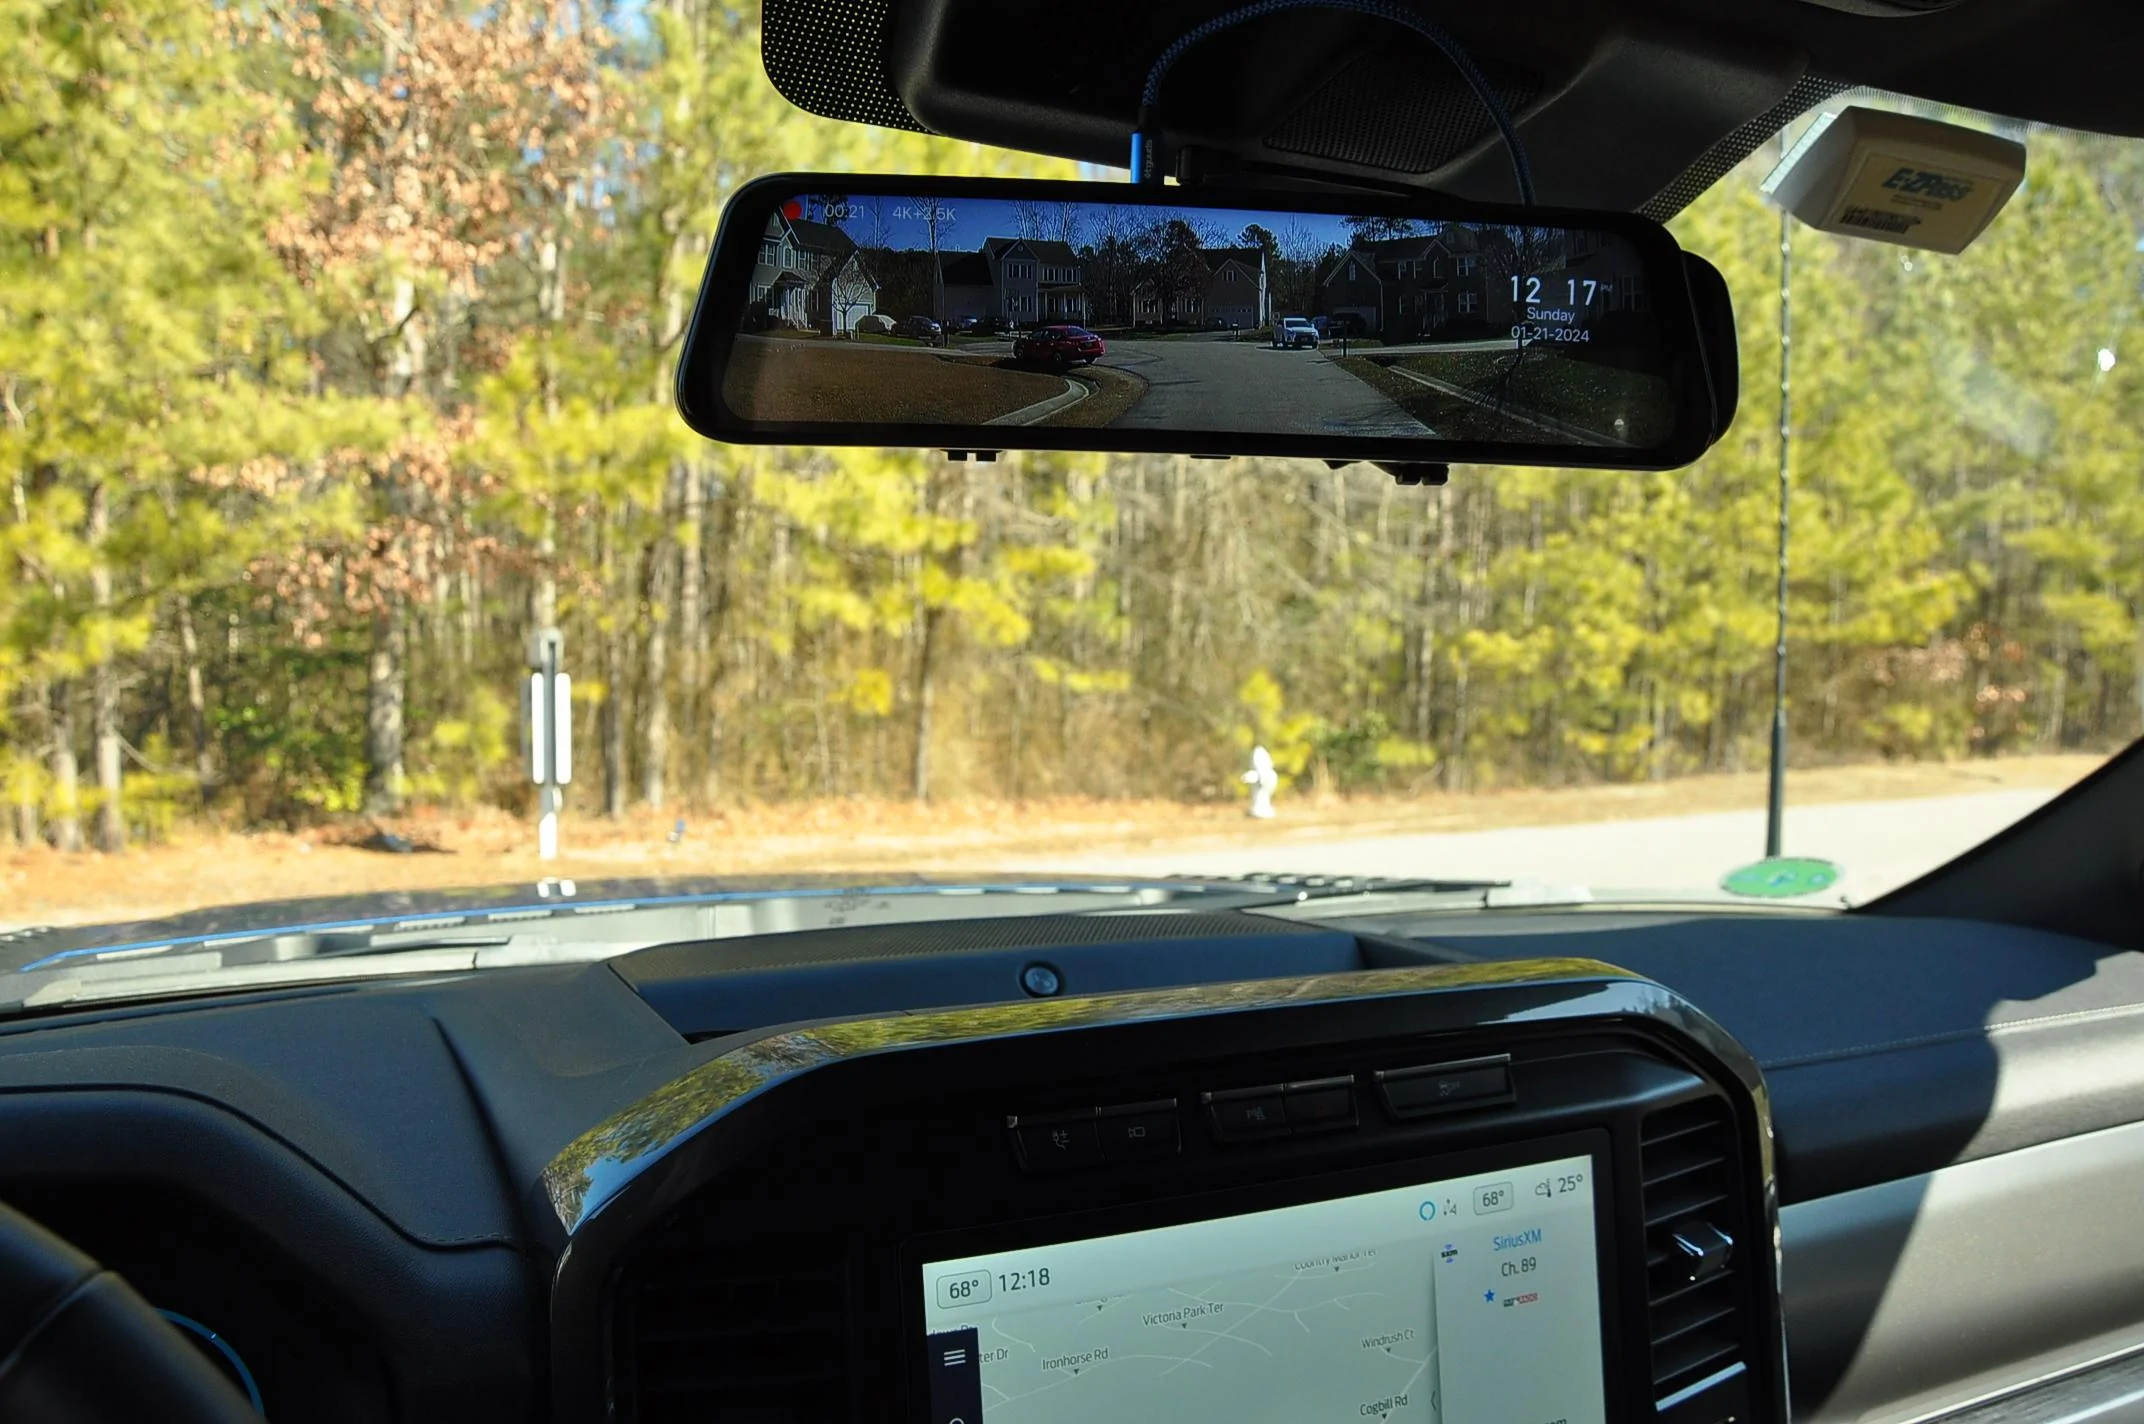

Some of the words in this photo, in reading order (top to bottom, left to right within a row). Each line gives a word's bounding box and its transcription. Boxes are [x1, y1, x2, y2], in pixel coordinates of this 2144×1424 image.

[825, 203, 865, 219] 00:21
[1526, 306, 1576, 325] Sunday
[1511, 325, 1590, 343] 01-21-2024
[1558, 1174, 1584, 1194] 25°
[1492, 1228, 1543, 1252] SiriusXM
[1521, 1256, 1537, 1273] 89
[949, 1279, 980, 1300] 68°
[998, 1267, 1051, 1293] 12:18
[1142, 1308, 1182, 1327] Victoria
[1183, 1304, 1206, 1319] Park
[1207, 1302, 1225, 1314] Ter
[1360, 1332, 1404, 1349] Windrush
[996, 1347, 1009, 1361] Dr
[1042, 1352, 1093, 1371] Ironhorse
[1094, 1347, 1109, 1361] Rd
[1360, 1397, 1394, 1416] Cogbill
[1394, 1393, 1409, 1408] Rd
